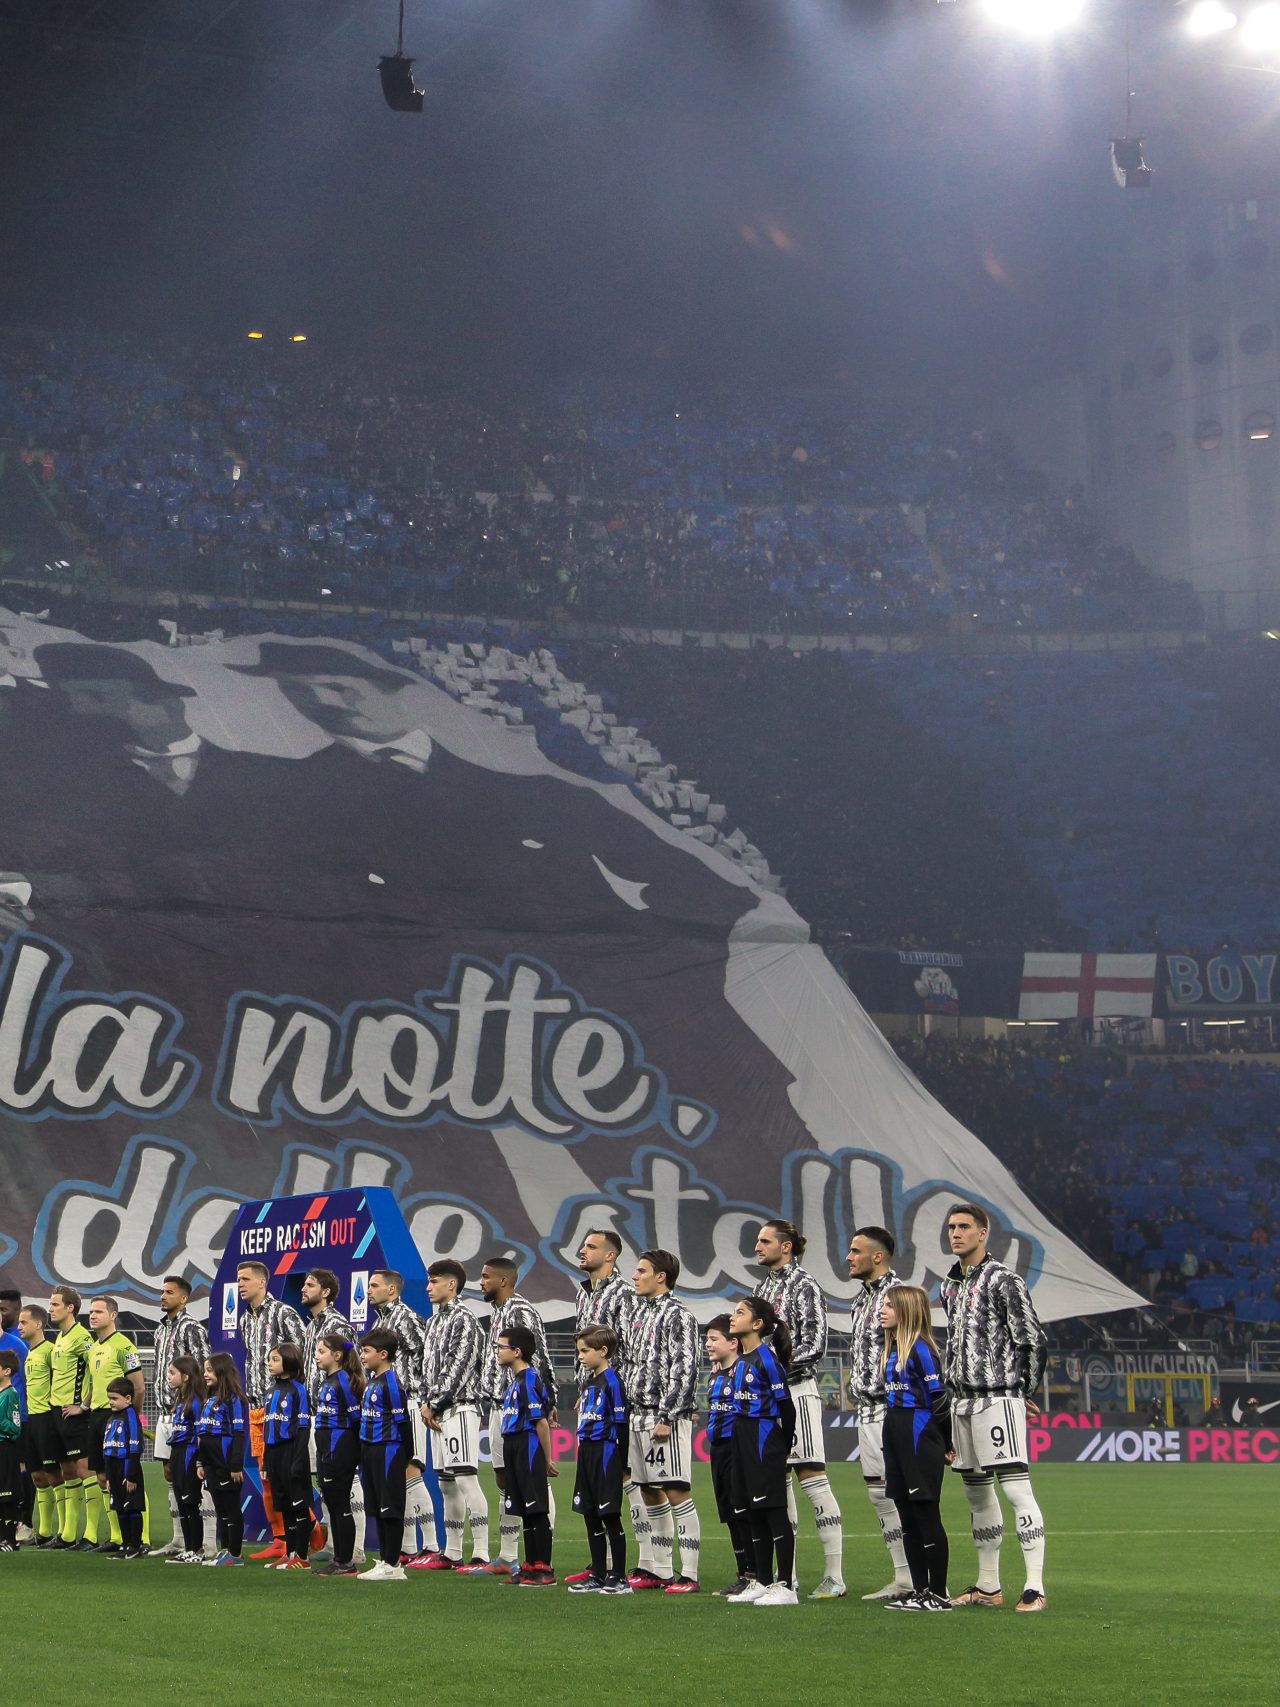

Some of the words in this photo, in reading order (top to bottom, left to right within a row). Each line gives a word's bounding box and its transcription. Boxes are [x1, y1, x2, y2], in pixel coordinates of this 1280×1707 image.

[1166, 954, 1277, 1004] BOY
[240, 1226, 272, 1255] KEEP
[276, 1220, 326, 1252] RACISM
[330, 1217, 357, 1246] OUT
[990, 1425, 1005, 1448] 9
[1075, 1430, 1181, 1462] MORE
[645, 1446, 666, 1467] 44
